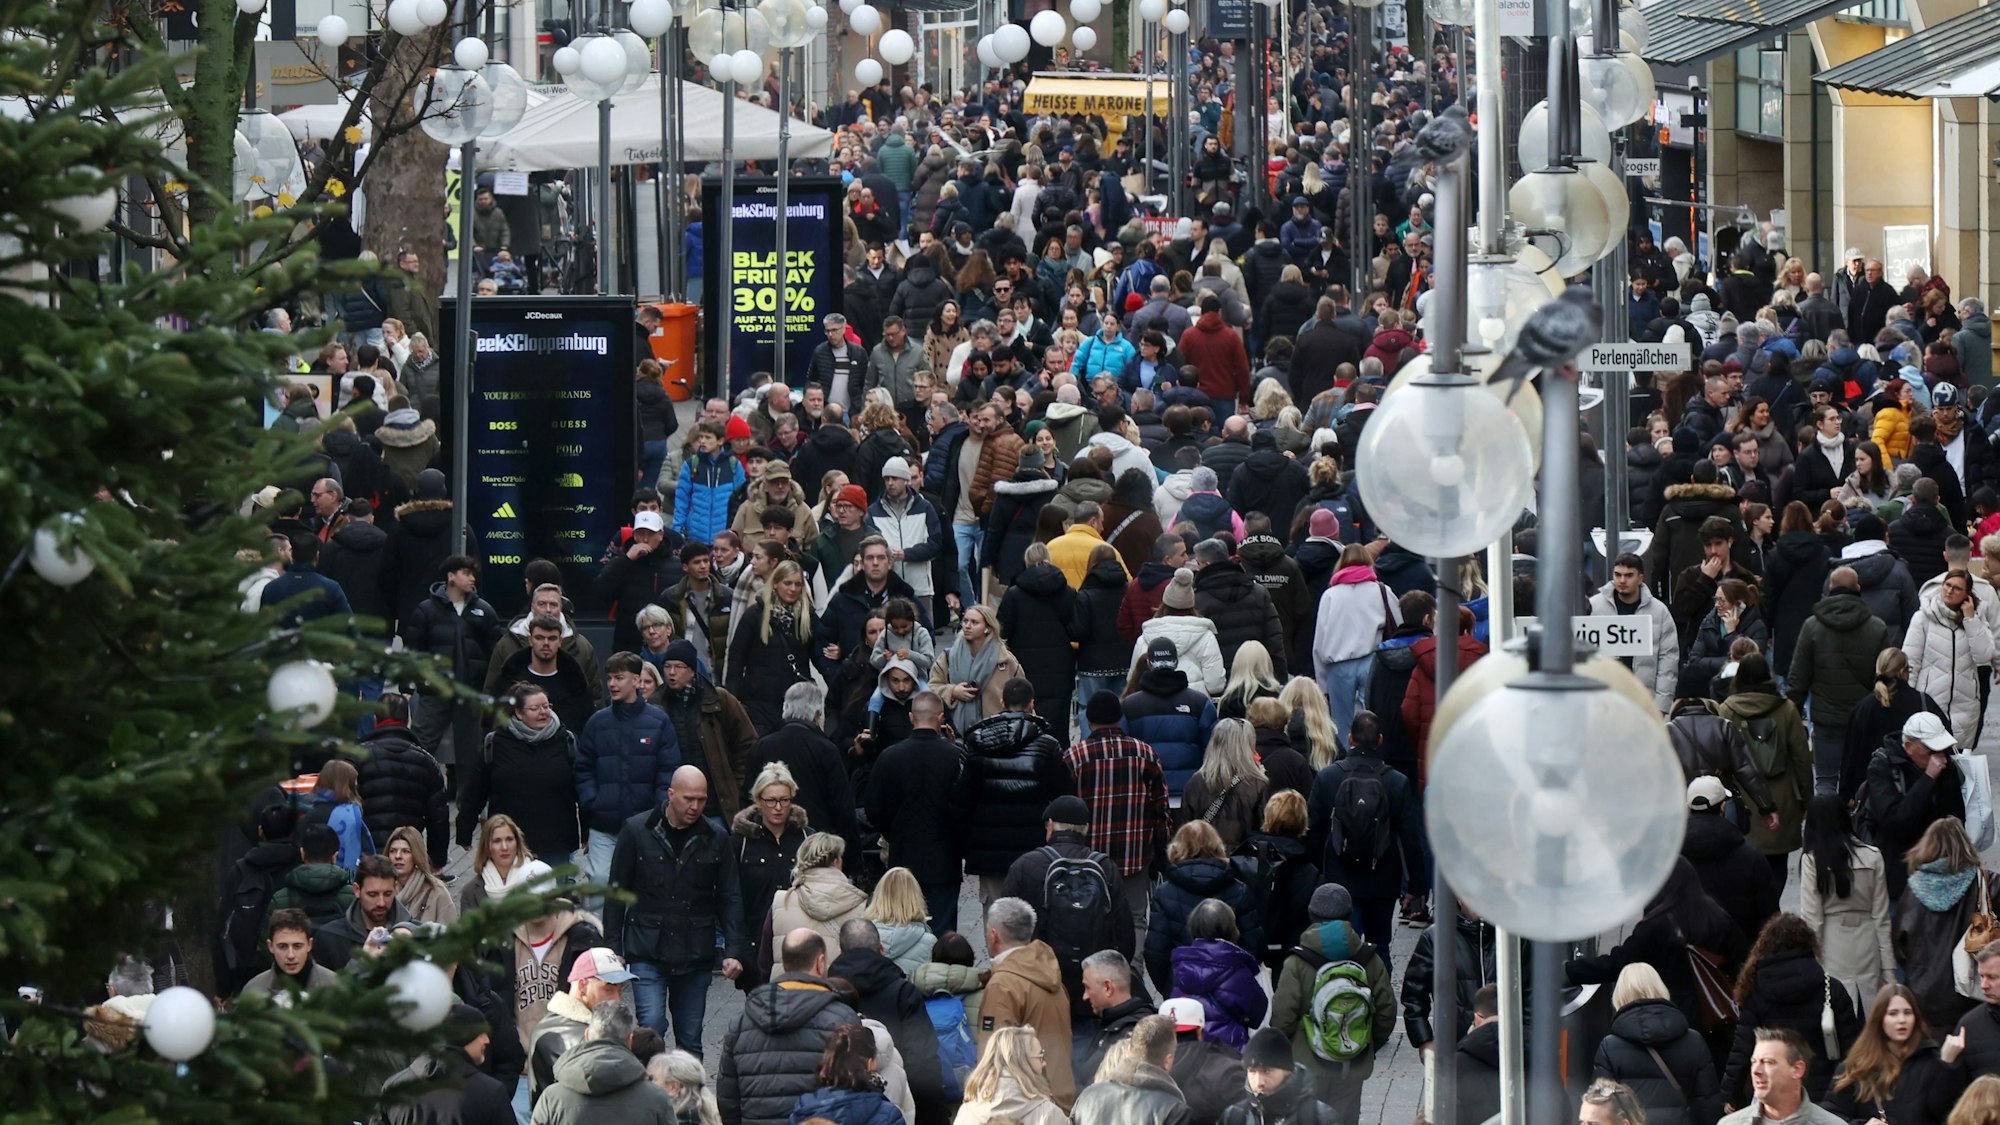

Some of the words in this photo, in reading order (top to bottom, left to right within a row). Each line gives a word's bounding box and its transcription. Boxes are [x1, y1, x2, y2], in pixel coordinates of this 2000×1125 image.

[1499, 0, 1530, 9] alando
[1033, 94, 1077, 109] HEISSE
[1626, 162, 1660, 174] zogstr.
[731, 202, 824, 221] eek&Clopenburg
[733, 251, 815, 268] BLACK
[734, 287, 815, 312] 30%
[525, 311, 563, 320] JCDecaux
[734, 315, 758, 324] AUF
[759, 314, 815, 324] TAUENDE
[739, 324, 763, 333] TOP
[476, 332, 607, 356] eek&Cloppenburg
[1592, 348, 1678, 369] Perlengäßchen
[483, 391, 509, 401] YOUR
[555, 390, 591, 400] BRANDS
[489, 421, 518, 431] BOSS
[552, 419, 588, 429] GUESS
[556, 444, 583, 454] POLO
[482, 475, 501, 483] Marc
[489, 555, 521, 564] HUGO
[573, 554, 593, 563] Klein
[1607, 624, 1642, 644] Str.
